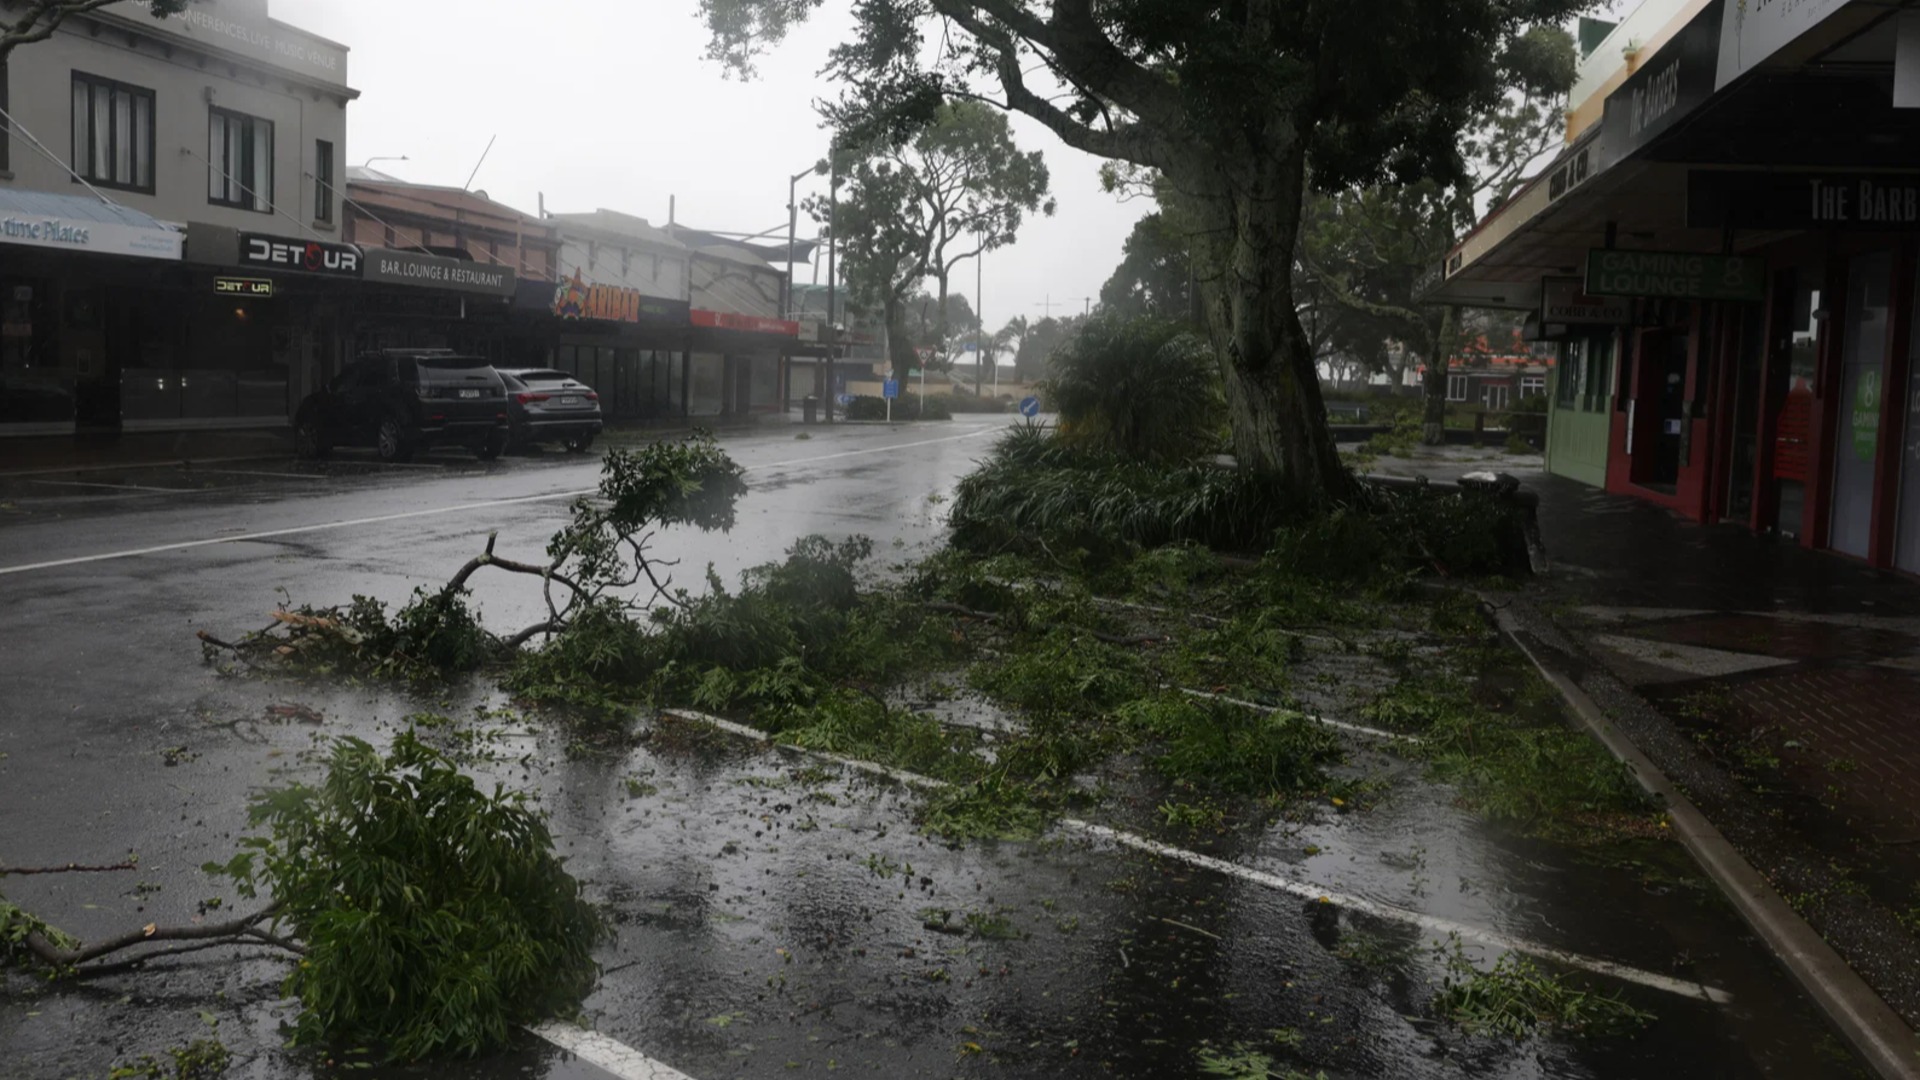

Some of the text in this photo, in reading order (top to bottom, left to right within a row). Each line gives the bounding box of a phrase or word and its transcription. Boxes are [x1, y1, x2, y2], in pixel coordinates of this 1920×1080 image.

[250, 31, 271, 49] LIVE
[275, 39, 304, 60] MUSIC
[307, 48, 337, 70] VENUE
[1809, 178, 1848, 221] THE
[0, 217, 90, 244] time Pilates
[249, 239, 357, 271] DETOUR
[1601, 252, 1704, 275] GAMING
[217, 281, 270, 293] DETOUR
[403, 262, 441, 281] LOUNGE
[443, 267, 450, 281] &
[451, 268, 503, 288] RESTAURANT
[1599, 272, 1703, 297] LOUNGE
[1550, 306, 1586, 318] COBB
[1589, 308, 1601, 318] &
